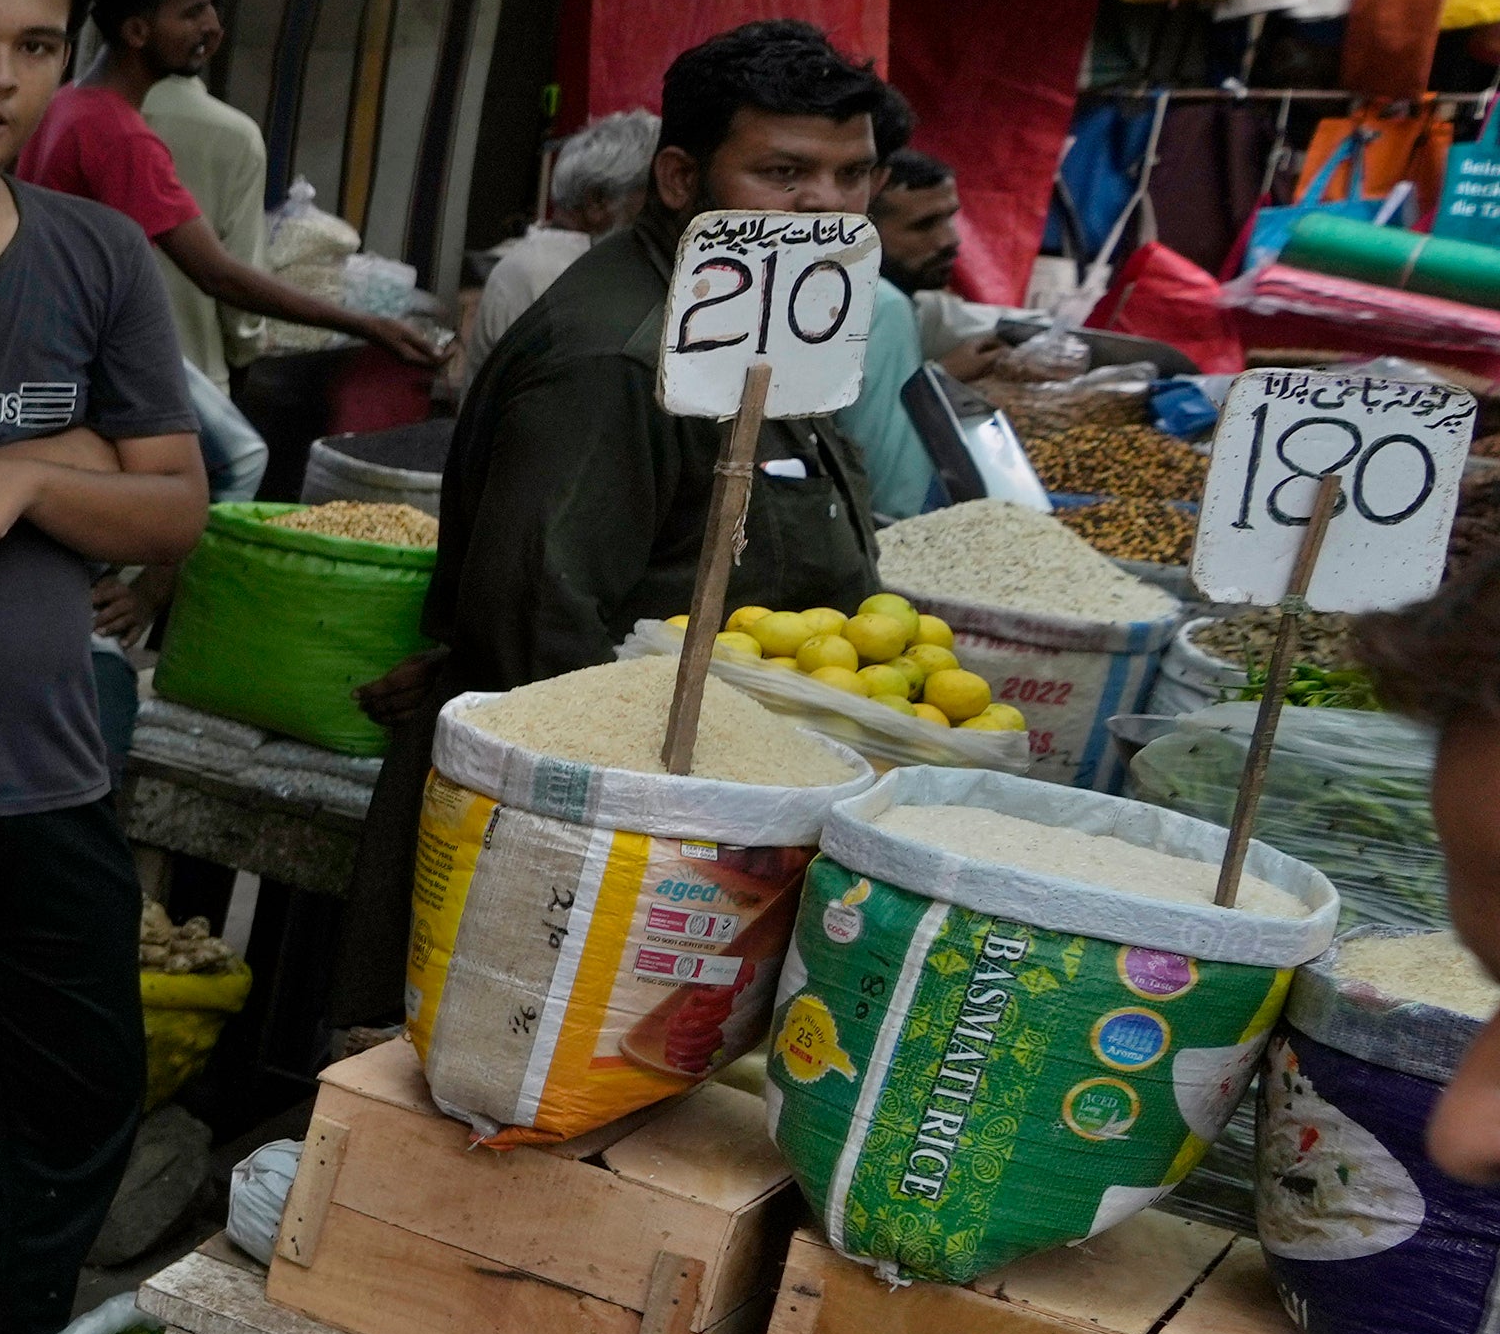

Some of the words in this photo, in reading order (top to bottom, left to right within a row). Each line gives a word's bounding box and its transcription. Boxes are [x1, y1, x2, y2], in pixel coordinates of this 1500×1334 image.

[742, 217, 794, 249] سیلا
[781, 217, 868, 245] کائنات
[676, 250, 852, 355] 210
[1229, 401, 1437, 531] 180
[1000, 676, 1074, 707] 2022
[655, 878, 722, 902] aged
[661, 937, 678, 947] 9001
[1148, 978, 1175, 993] Taste
[931, 929, 1031, 1105] BASMATI
[796, 1026, 815, 1049] 25
[1107, 1044, 1145, 1062] Aroma
[899, 1106, 966, 1202] RICE
